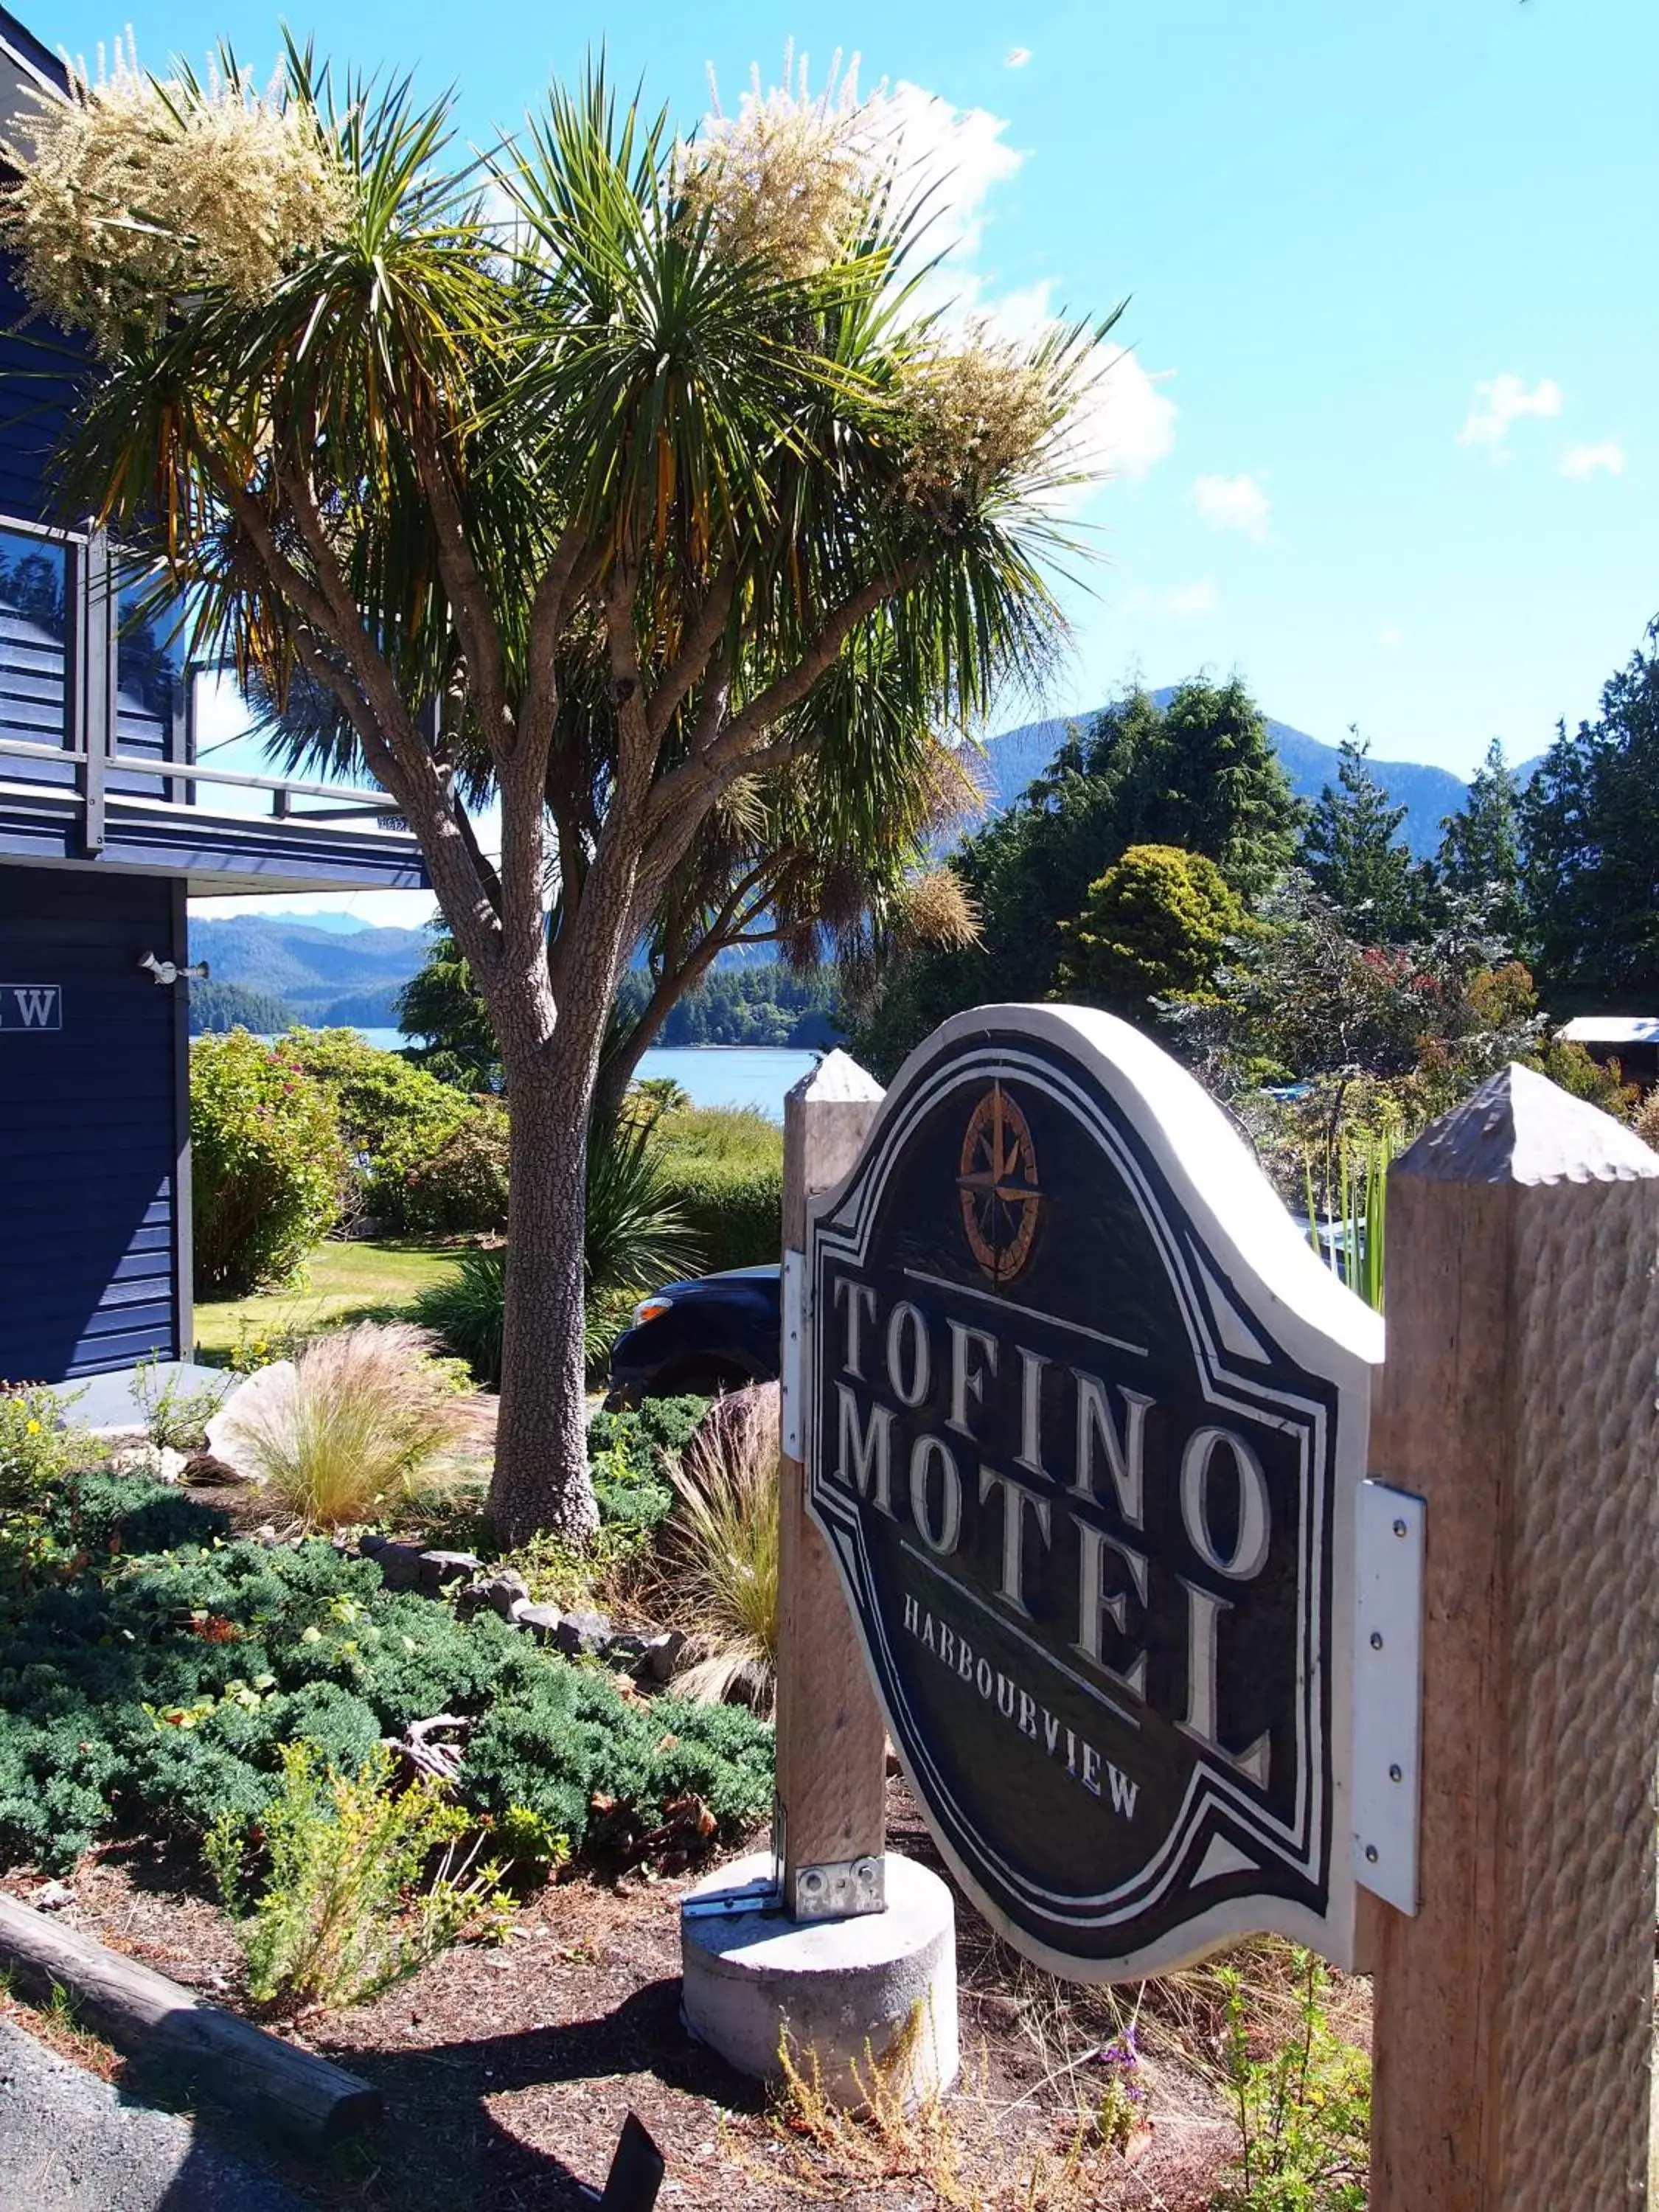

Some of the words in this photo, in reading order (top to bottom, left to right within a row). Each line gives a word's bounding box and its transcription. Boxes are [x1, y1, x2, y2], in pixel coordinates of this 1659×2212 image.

[0, 990, 56, 1026] W
[834, 1276, 1271, 1581] TOFINO
[833, 1381, 1270, 1790] MOTEL
[903, 1593, 1141, 1821] HARBOURVIEW
